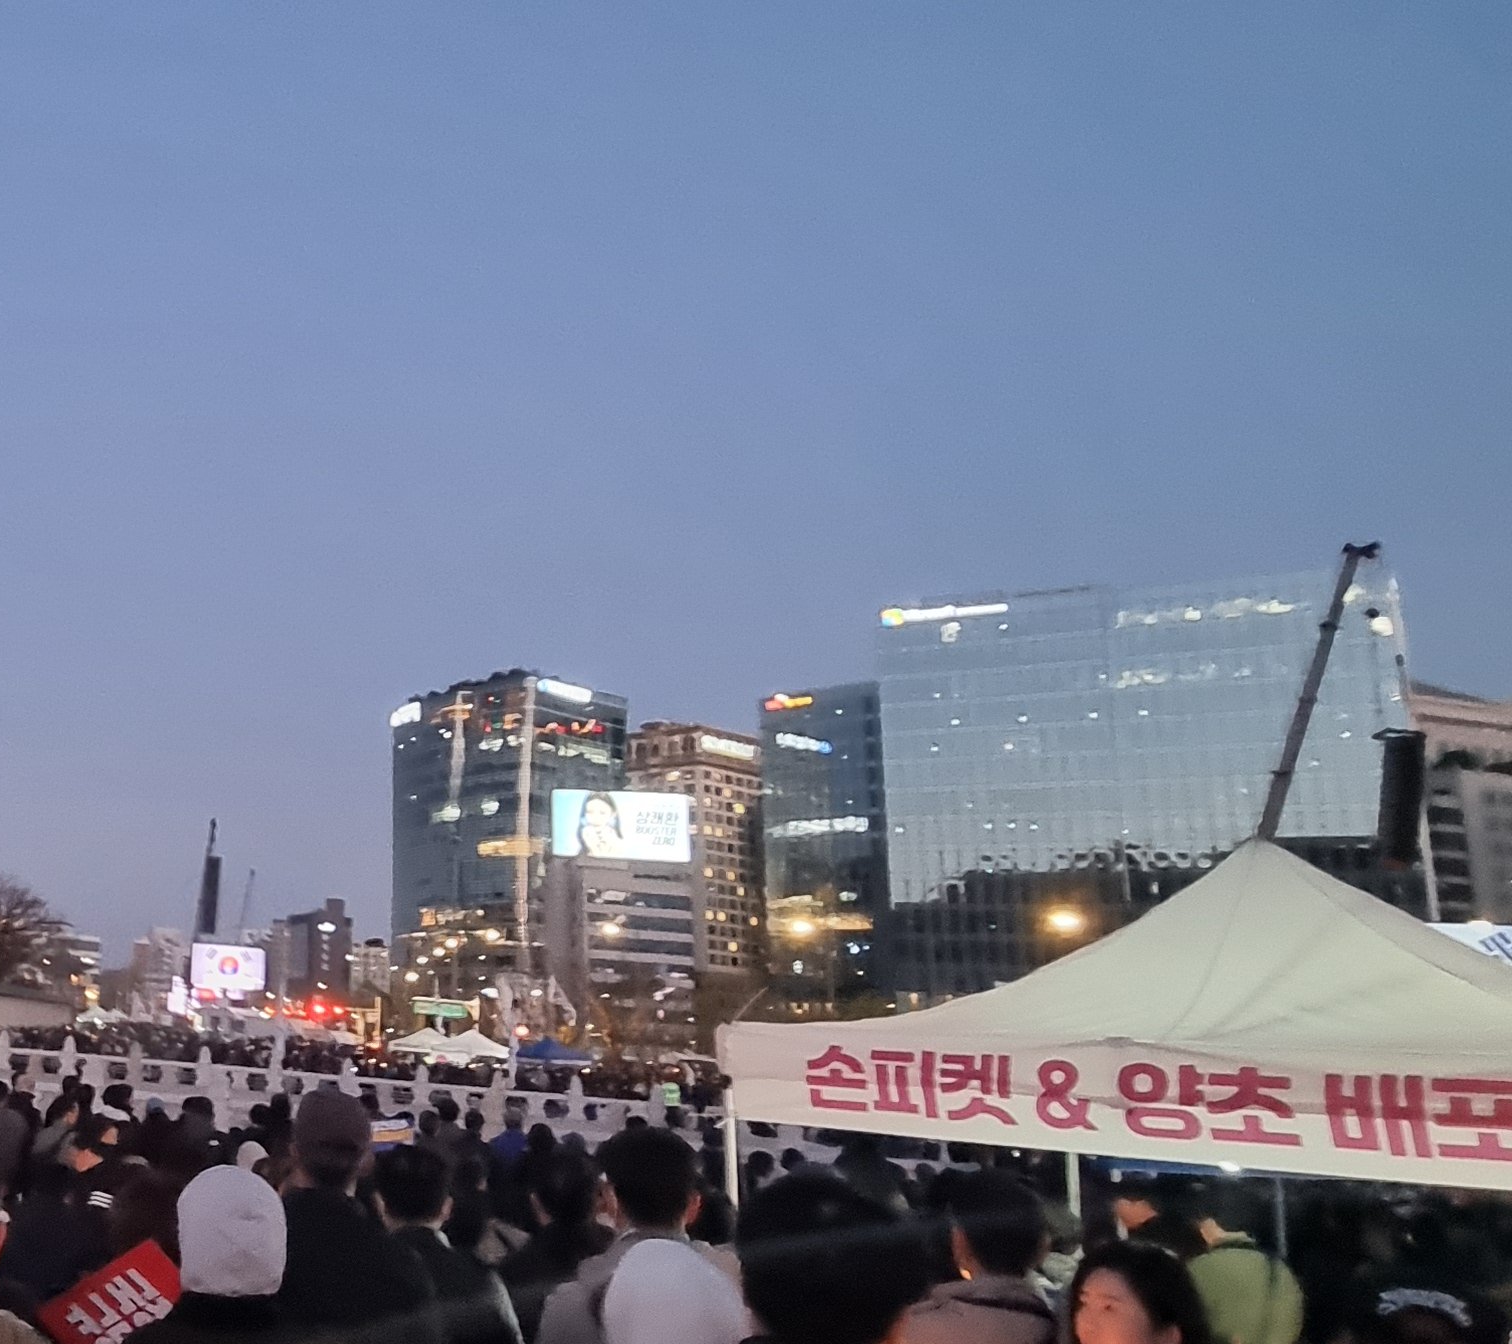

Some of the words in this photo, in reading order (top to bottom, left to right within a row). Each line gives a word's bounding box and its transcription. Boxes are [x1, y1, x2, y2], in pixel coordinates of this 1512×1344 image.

[805, 1045, 1018, 1126] 손피켓
[1036, 1059, 1099, 1132] &
[1117, 1062, 1303, 1147] 양초
[1324, 1074, 1512, 1162] 배포
